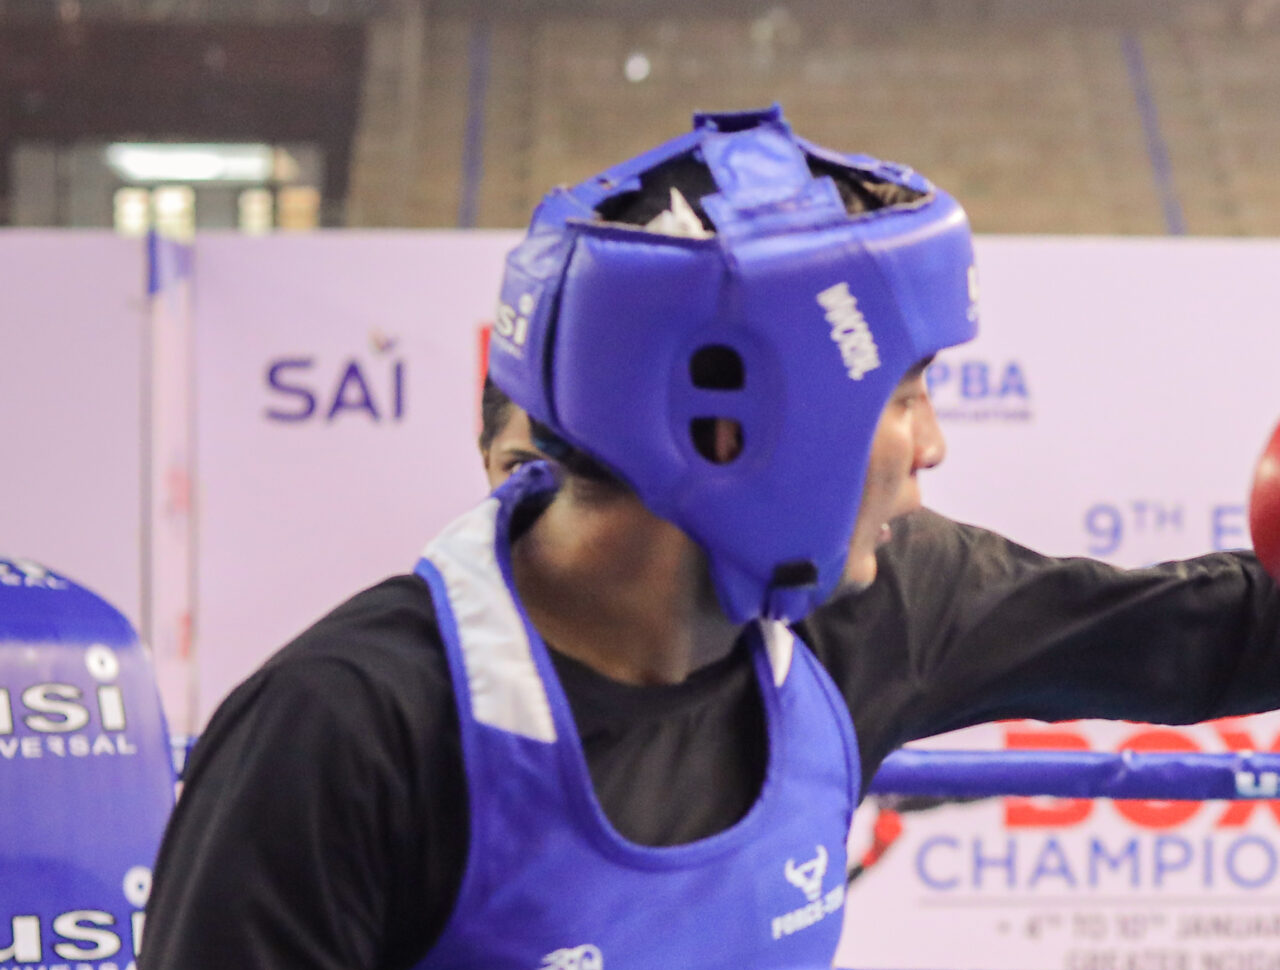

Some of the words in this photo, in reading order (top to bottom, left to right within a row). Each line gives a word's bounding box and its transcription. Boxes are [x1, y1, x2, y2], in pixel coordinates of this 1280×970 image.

[264, 357, 405, 422] SAI
[0, 643, 126, 735] si
[0, 733, 138, 760] VERSAL
